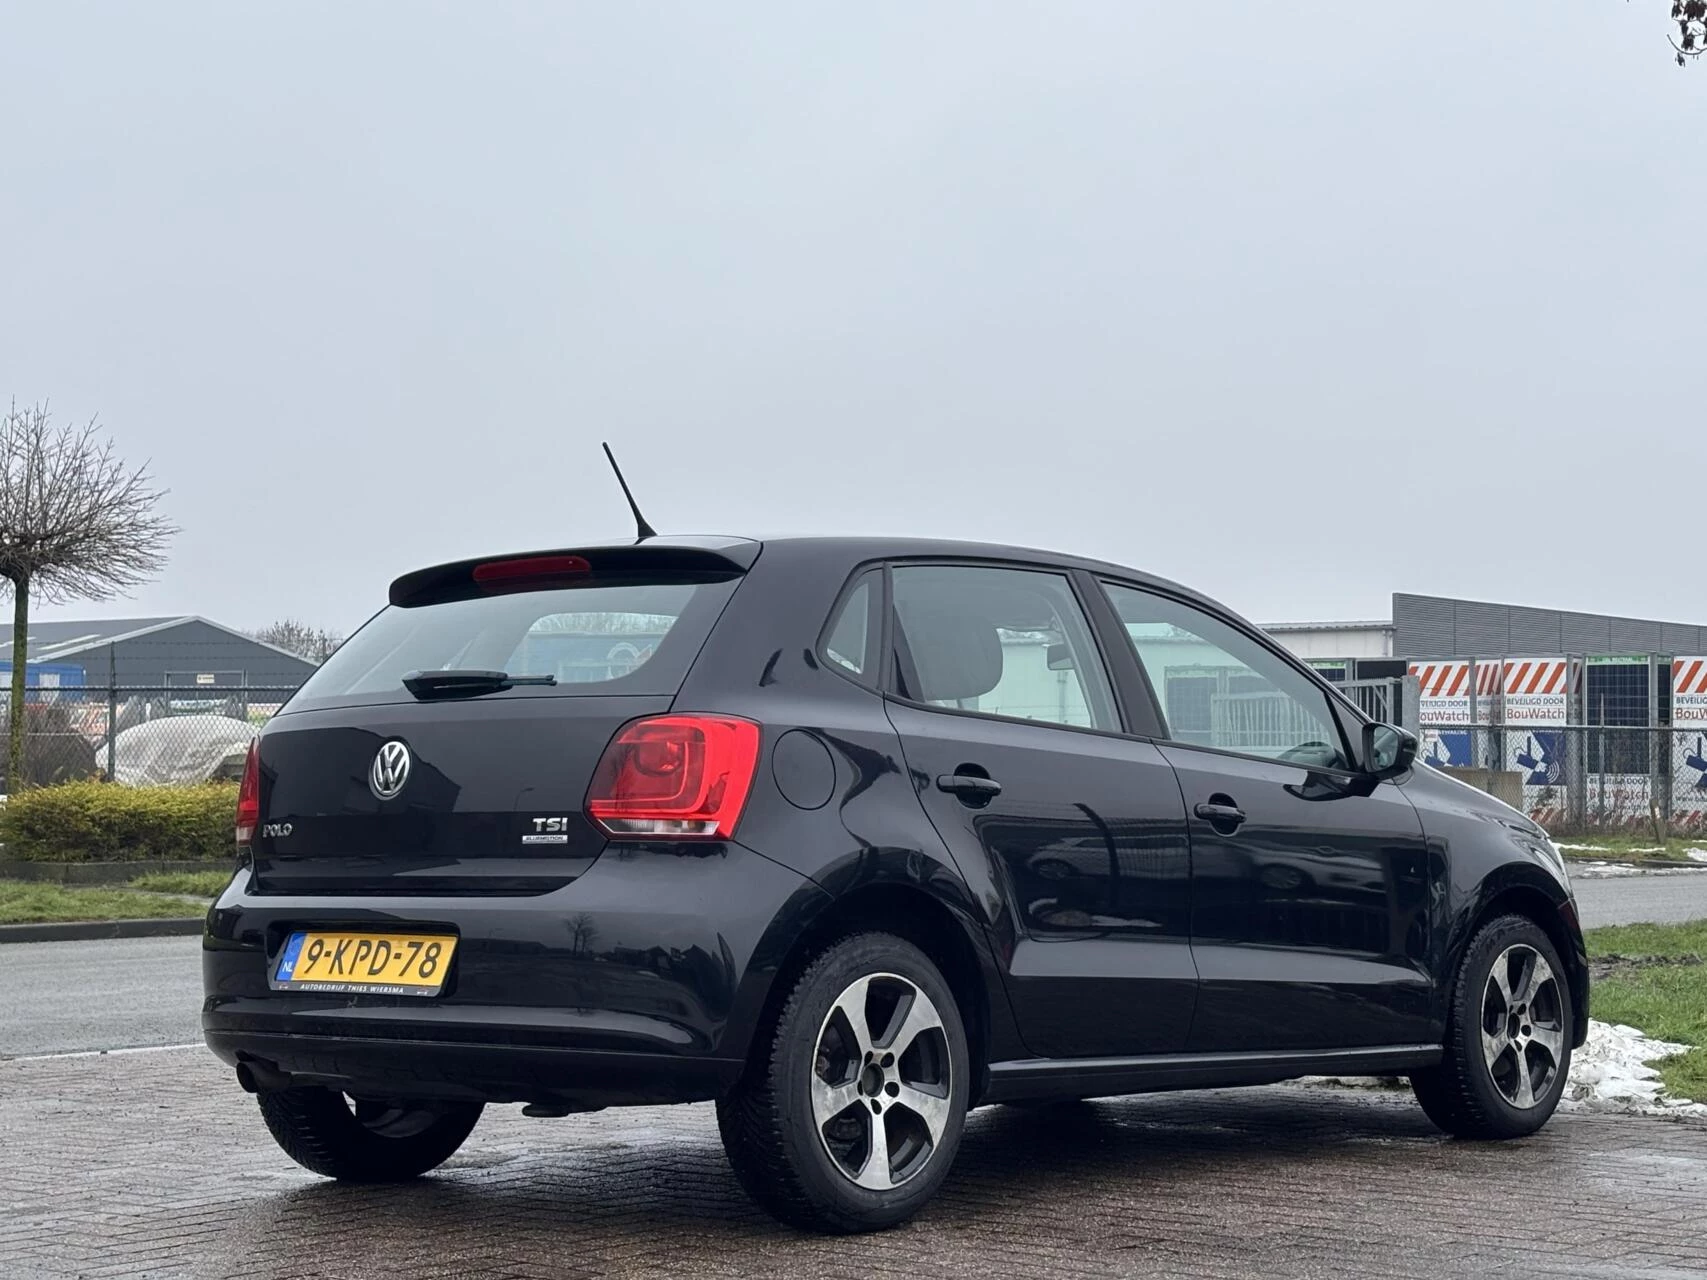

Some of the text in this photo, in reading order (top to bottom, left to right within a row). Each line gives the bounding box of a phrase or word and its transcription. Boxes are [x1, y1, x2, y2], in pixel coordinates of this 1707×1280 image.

[1543, 697, 1565, 705] DOOR
[1676, 696, 1707, 705] BEVEILIG
[1420, 710, 1469, 721] ouWatch
[1506, 708, 1565, 720] BouWatch
[1675, 707, 1707, 720] BouW
[262, 823, 293, 838] POLO
[532, 817, 568, 832] TSI
[304, 938, 442, 979] 9-KPD-78
[282, 961, 293, 973] NL
[300, 983, 346, 992] AUTOBEDRIJF
